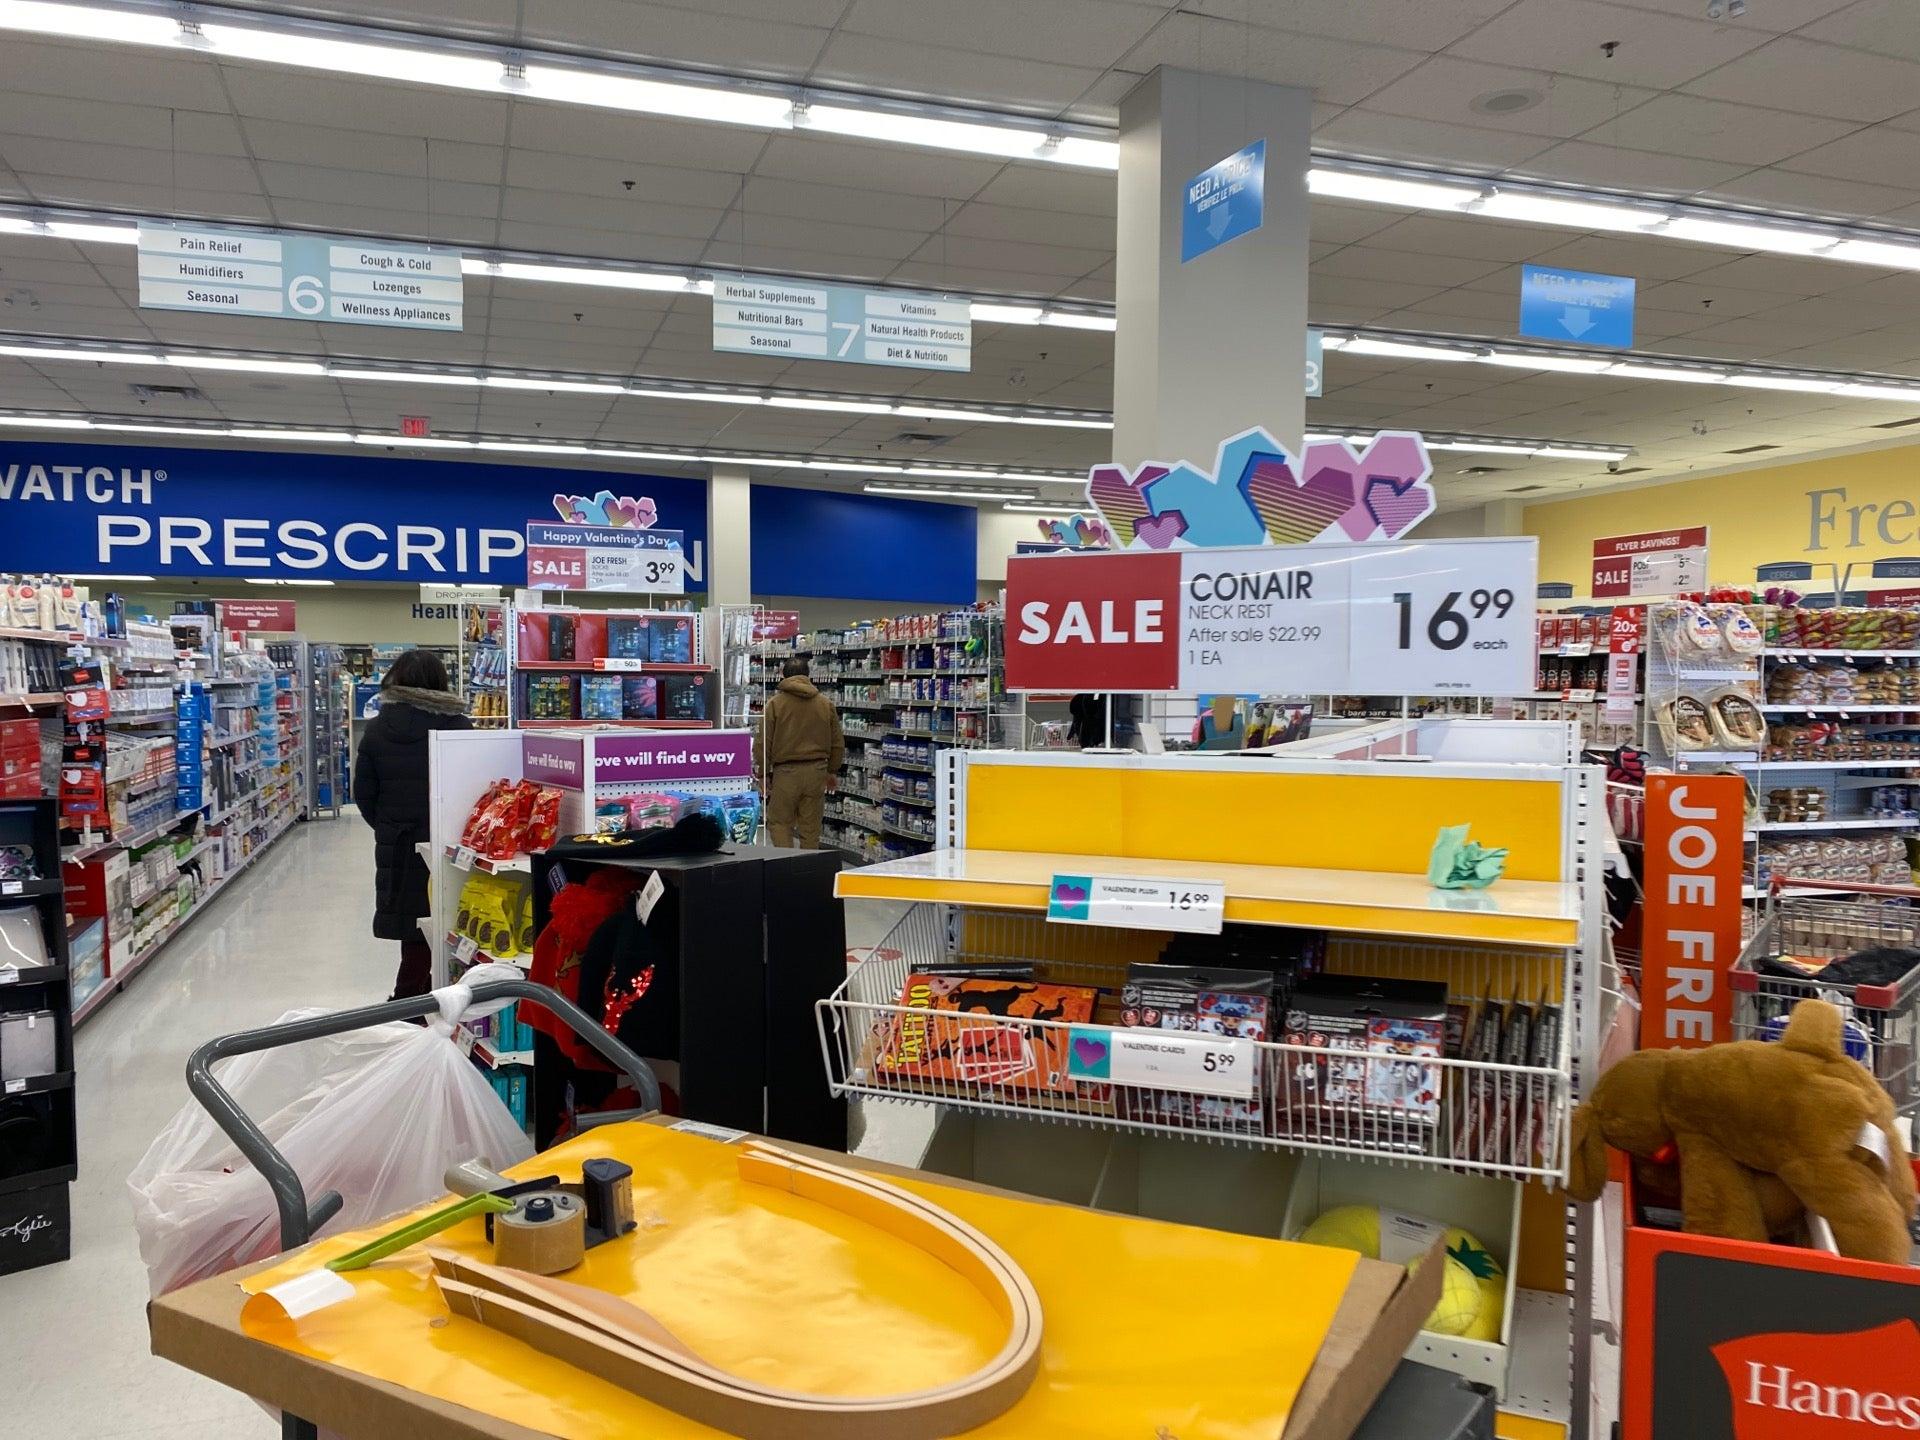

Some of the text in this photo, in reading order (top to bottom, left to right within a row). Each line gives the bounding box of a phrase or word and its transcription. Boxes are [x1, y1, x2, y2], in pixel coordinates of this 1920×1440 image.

[1189, 178, 1211, 204] NEED
[1213, 174, 1220, 191] A
[180, 237, 242, 253] Pain Relief
[360, 254, 431, 271] Cough & Cold
[179, 264, 244, 279] Humidifiers
[288, 275, 325, 315] 6
[373, 280, 422, 295] Lozenges
[726, 286, 816, 305] Herbal Supplements
[187, 290, 239, 305] Seasonal
[342, 303, 451, 321] Wellness Appliances
[901, 304, 937, 316] Vitamins
[738, 311, 803, 327] Nutritional Bars
[832, 322, 860, 357] 7
[871, 324, 964, 341] Natural Health Products
[750, 335, 791, 348] Seasonal
[887, 347, 948, 362] Diet & Nutrition
[1802, 487, 1920, 552] Fre
[543, 530, 670, 547] Happy Valentine's Day
[1616, 536, 1680, 552] FLYER SAVINGS!
[532, 560, 581, 576] SALE
[591, 557, 627, 565] JOE FRESH
[1595, 570, 1629, 585] SALE
[1769, 571, 1798, 580] CEREAL
[1190, 570, 1313, 601] CONAIR
[436, 591, 463, 599] DROP
[1189, 604, 1273, 619] NECK REST
[1017, 600, 1164, 645] SALE
[1613, 620, 1638, 632] 20x
[1188, 626, 1321, 642] After sale $22.99
[1473, 639, 1508, 650] each
[1190, 650, 1223, 665] 1 EA
[527, 751, 539, 765] Love
[539, 753, 548, 766] will
[548, 753, 558, 768] find
[563, 760, 576, 775] way
[595, 751, 735, 767] ove will find a way
[1102, 885, 1158, 895] VALENTINE PLUSH
[1665, 785, 1717, 1048] JOE FRE
[1122, 1042, 1159, 1053] VALENTINE
[1, 1214, 52, 1243] Kylie
[1745, 1360, 1920, 1431] Hanes
